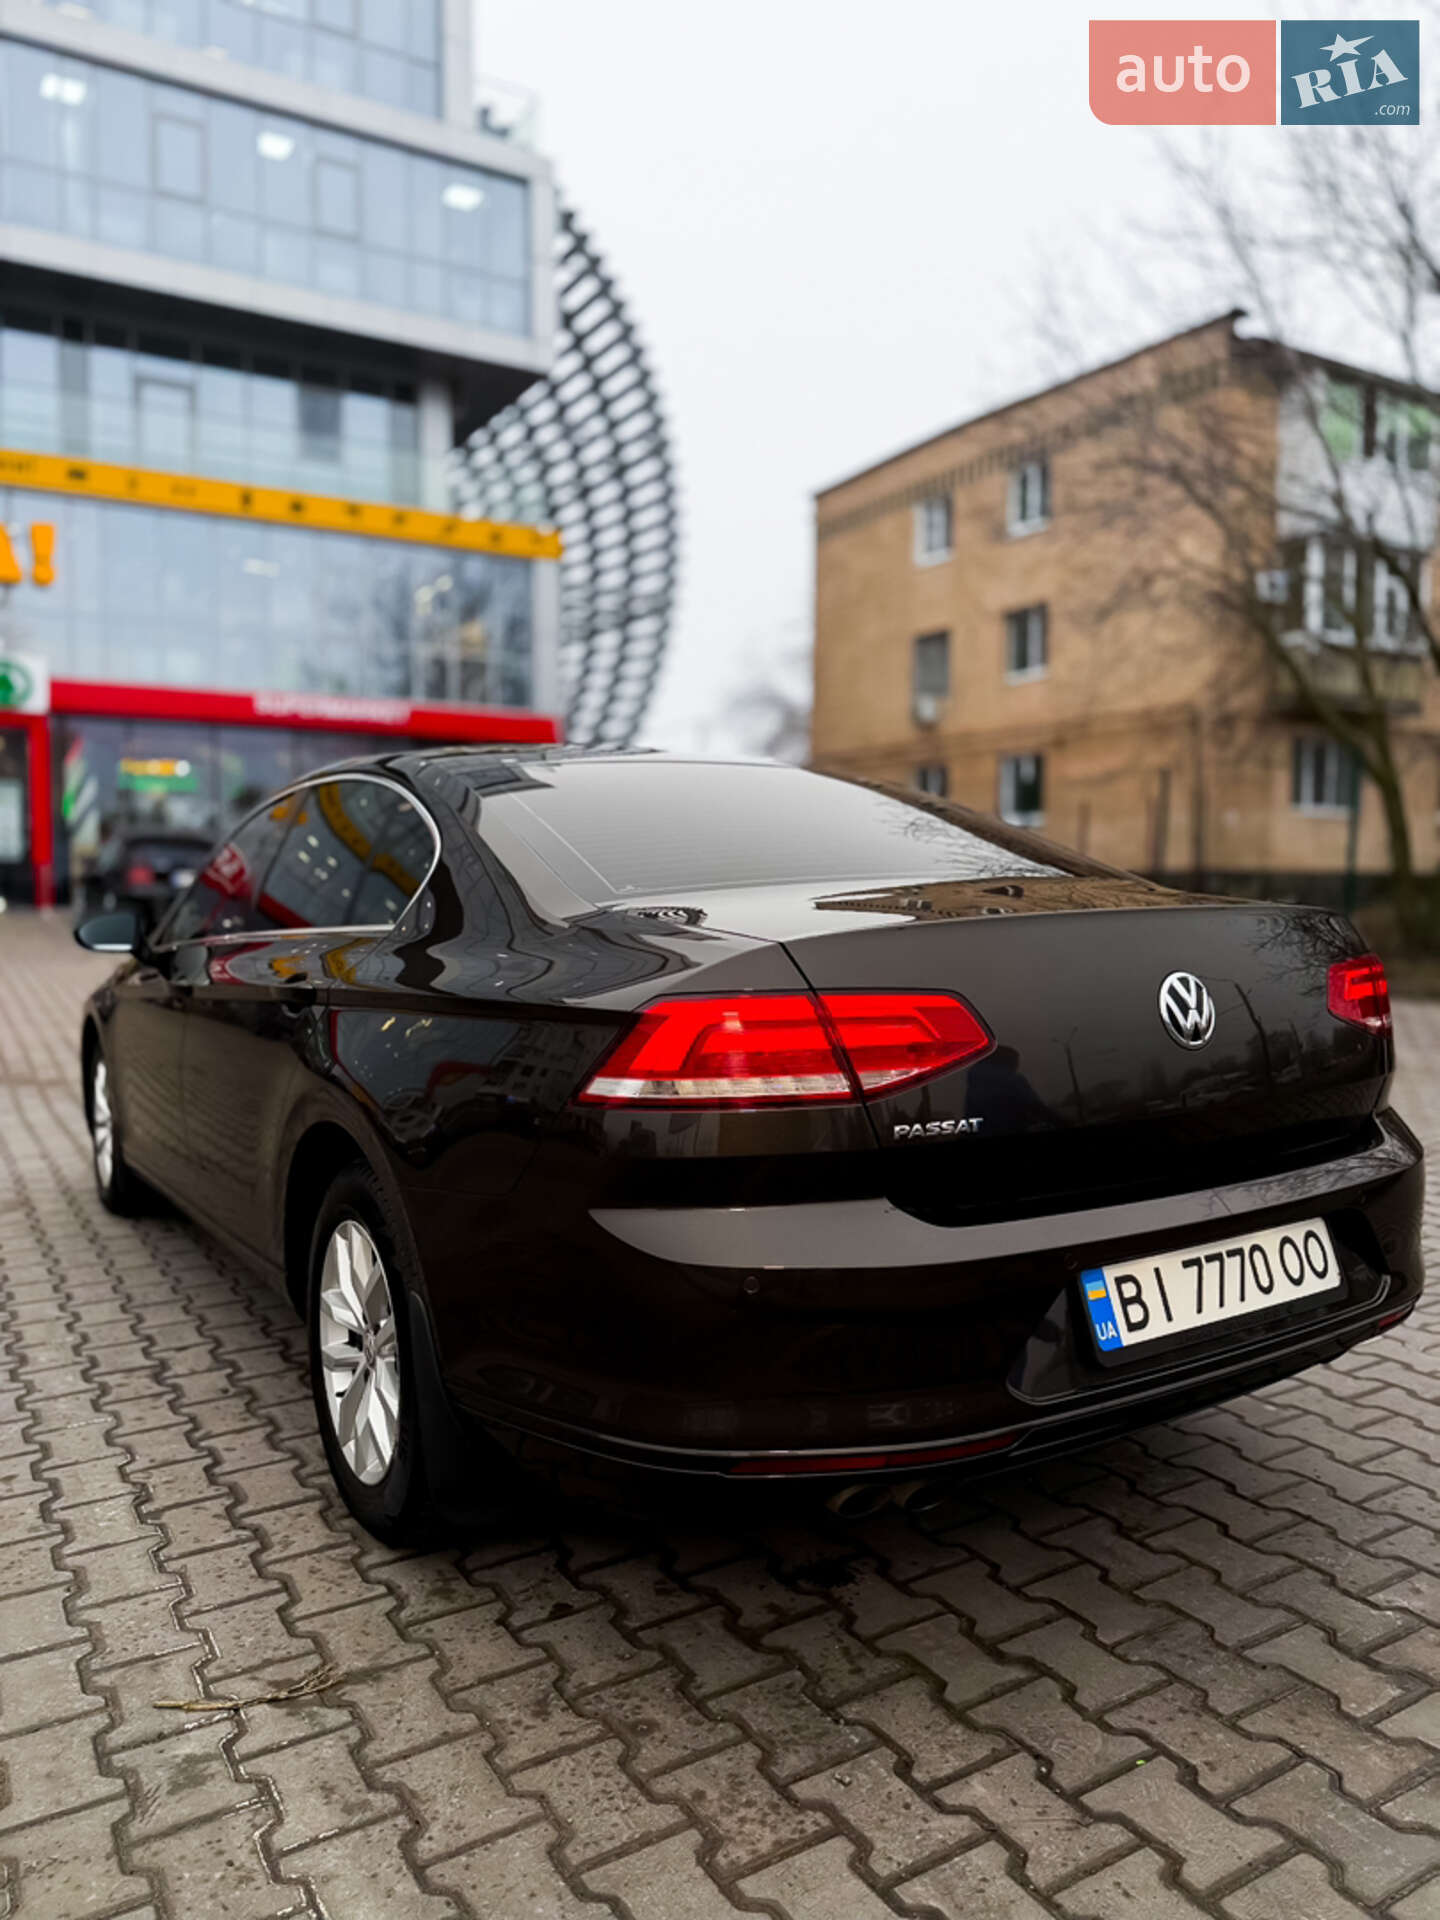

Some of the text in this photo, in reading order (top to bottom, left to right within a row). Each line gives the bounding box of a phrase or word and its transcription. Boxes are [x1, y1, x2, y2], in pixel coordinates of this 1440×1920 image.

[893, 1117, 984, 1140] PASSAT
[1114, 1266, 1173, 1333] BI
[1182, 1243, 1275, 1315] 7770
[1095, 1322, 1118, 1341] UA
